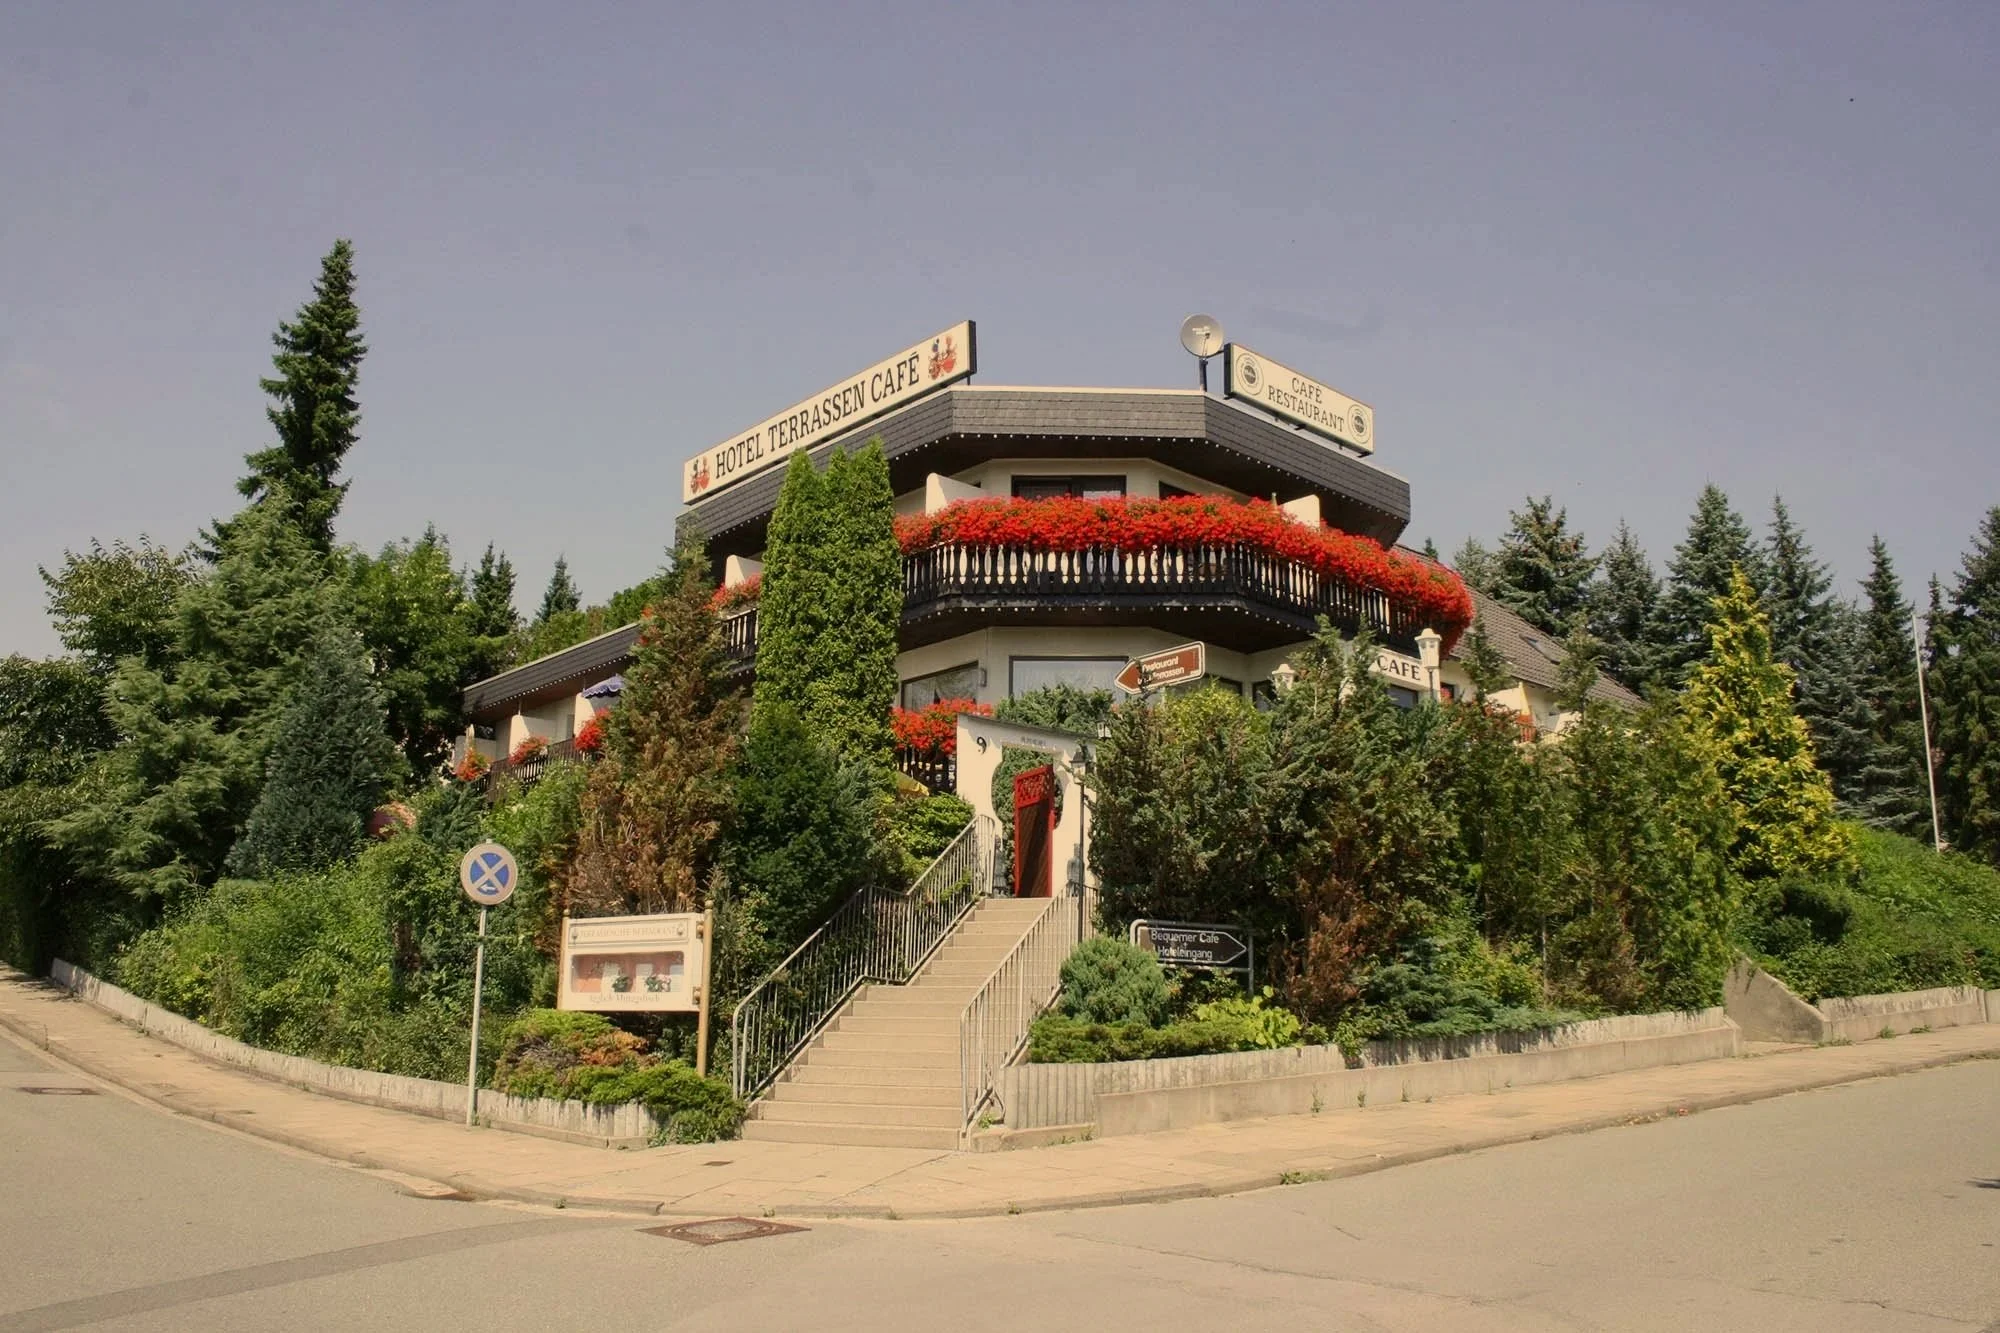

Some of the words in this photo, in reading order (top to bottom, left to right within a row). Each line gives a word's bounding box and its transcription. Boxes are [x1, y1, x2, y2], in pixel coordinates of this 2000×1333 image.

[715, 432, 764, 479] HOTEL
[767, 380, 866, 453] TERRASSEN
[870, 351, 920, 403] CAFÉ
[1267, 384, 1345, 433] RESTAURANT
[1377, 655, 1421, 681] CAFE
[976, 736, 988, 755] 9
[1151, 929, 1198, 943] Bequemer
